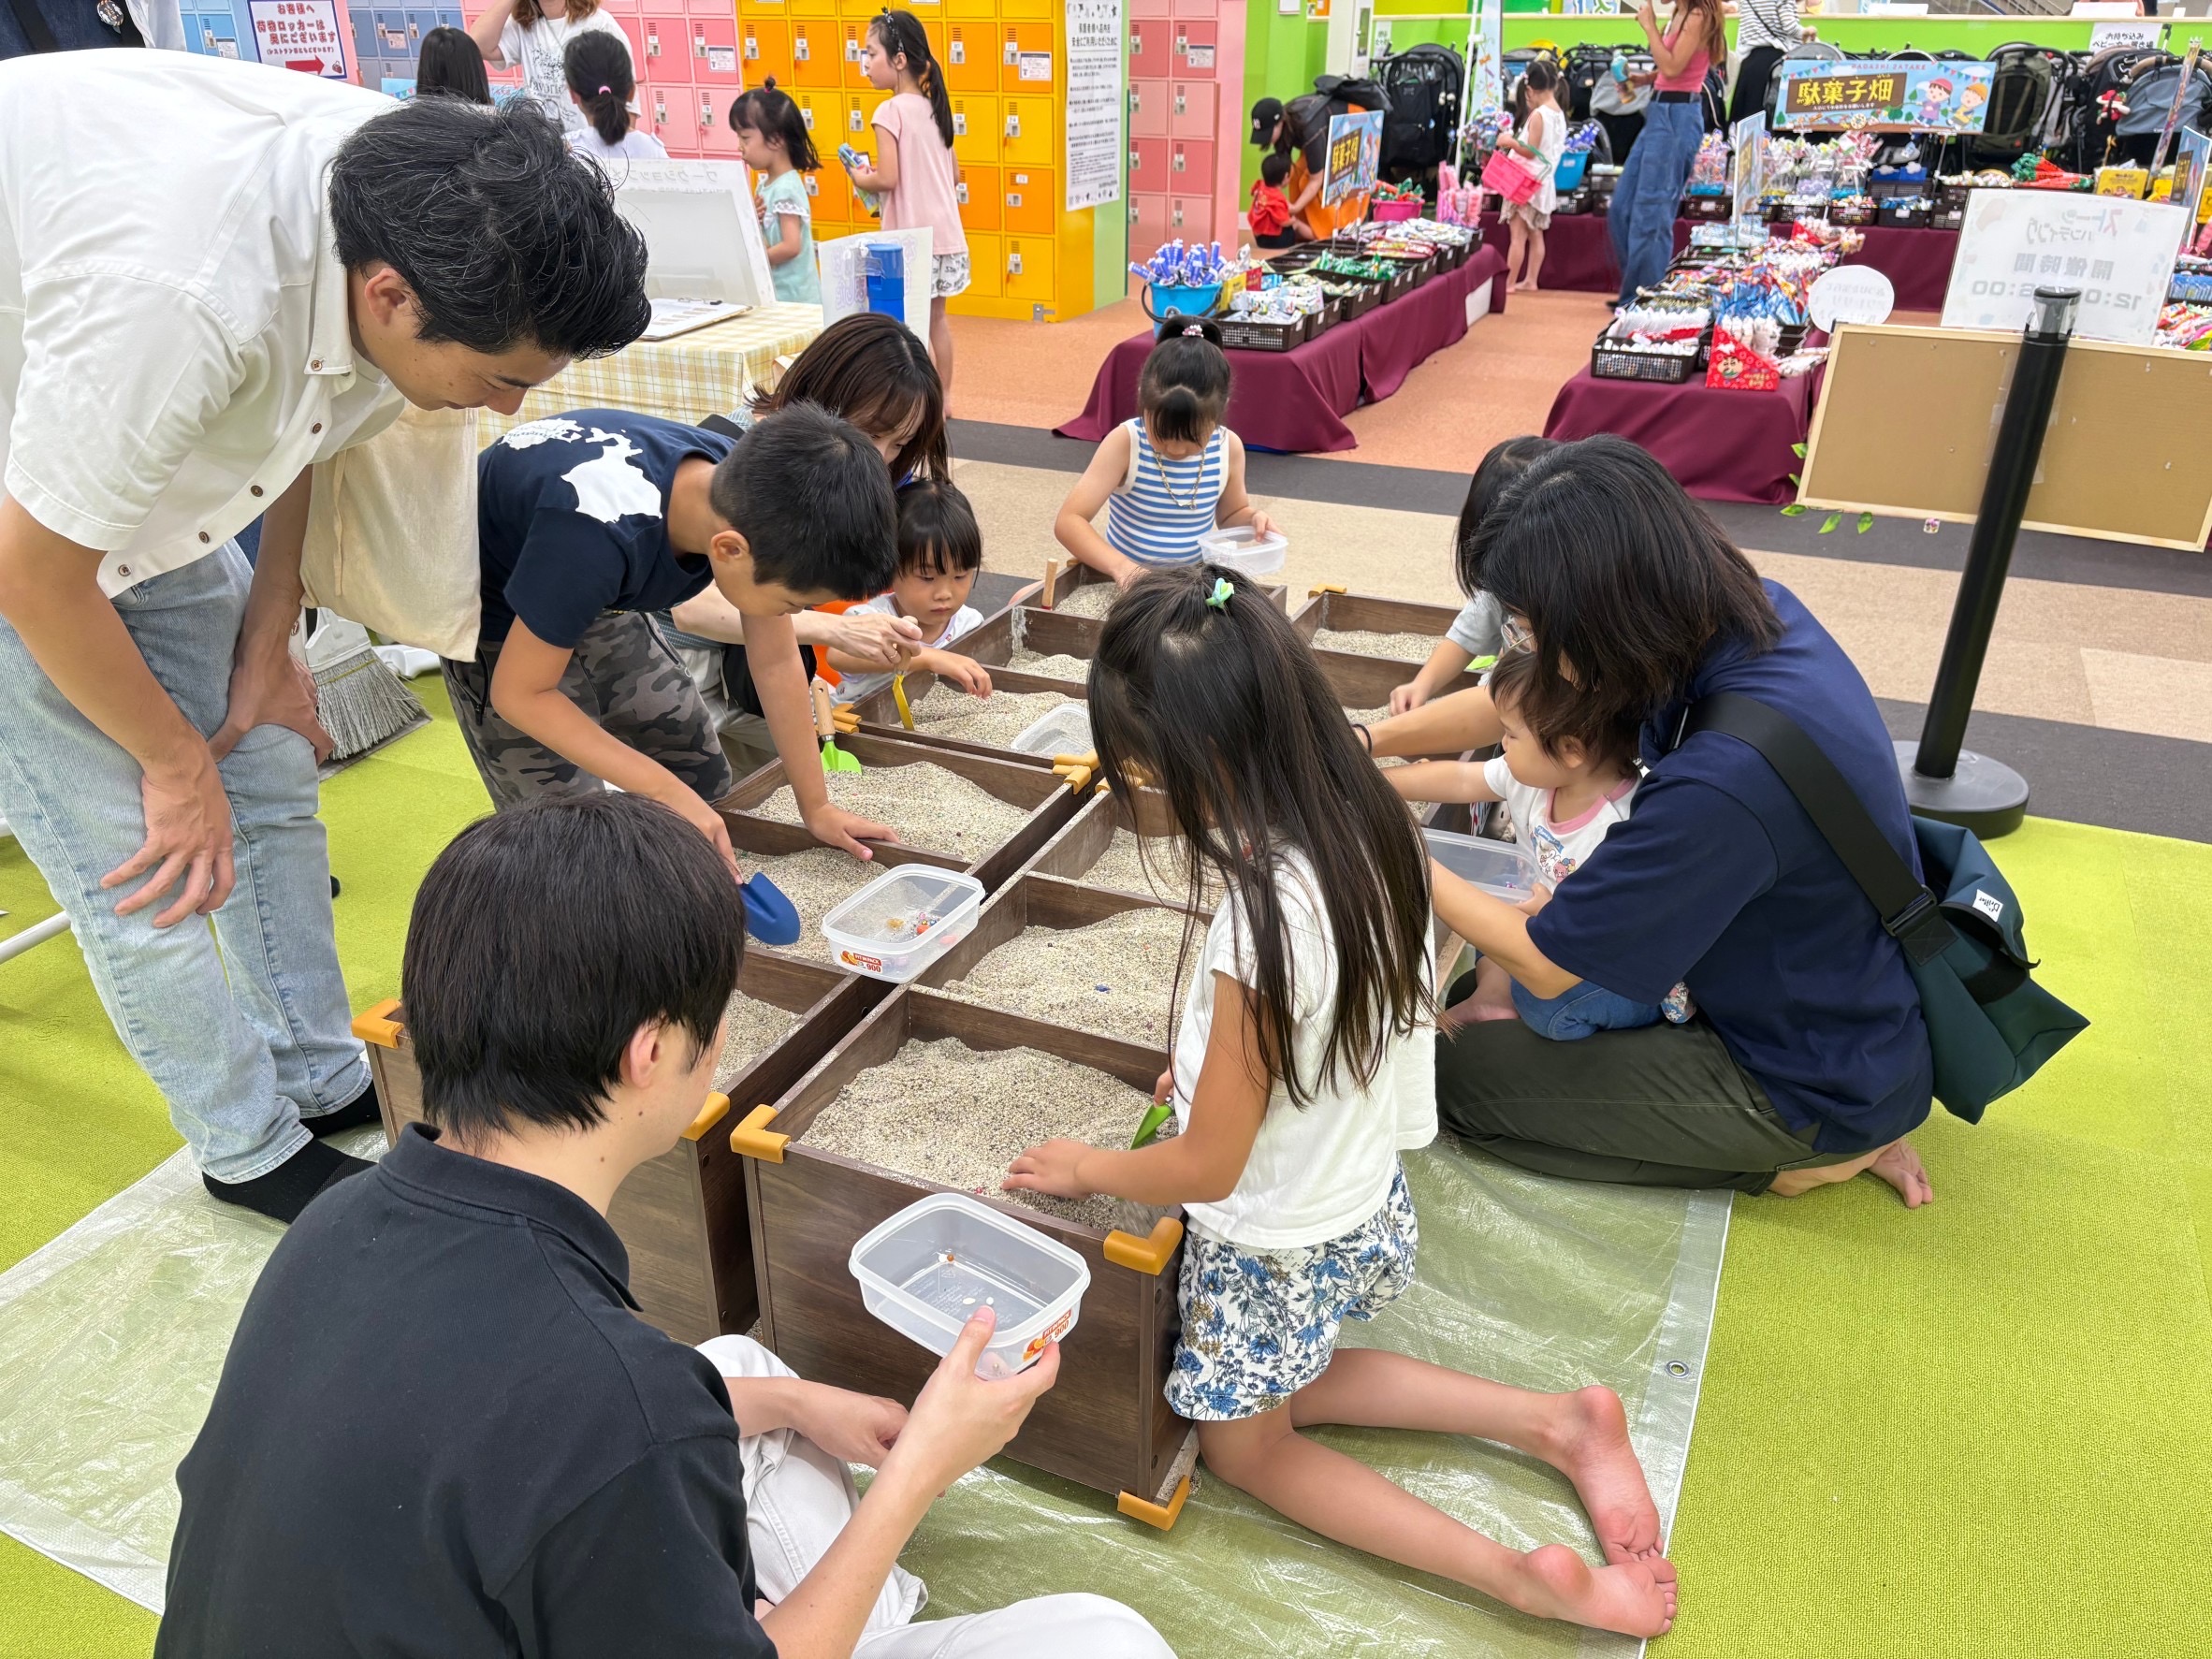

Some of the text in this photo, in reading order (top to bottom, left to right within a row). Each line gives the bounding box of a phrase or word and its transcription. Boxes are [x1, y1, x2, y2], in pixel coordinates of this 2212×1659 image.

[256, 19, 326, 33] 荷物ロッカーは
[269, 31, 336, 45] 奥にございます
[1797, 78, 1895, 106] 駄菓子畑
[866, 963, 881, 972] 900
[1055, 1319, 1069, 1338] 900
